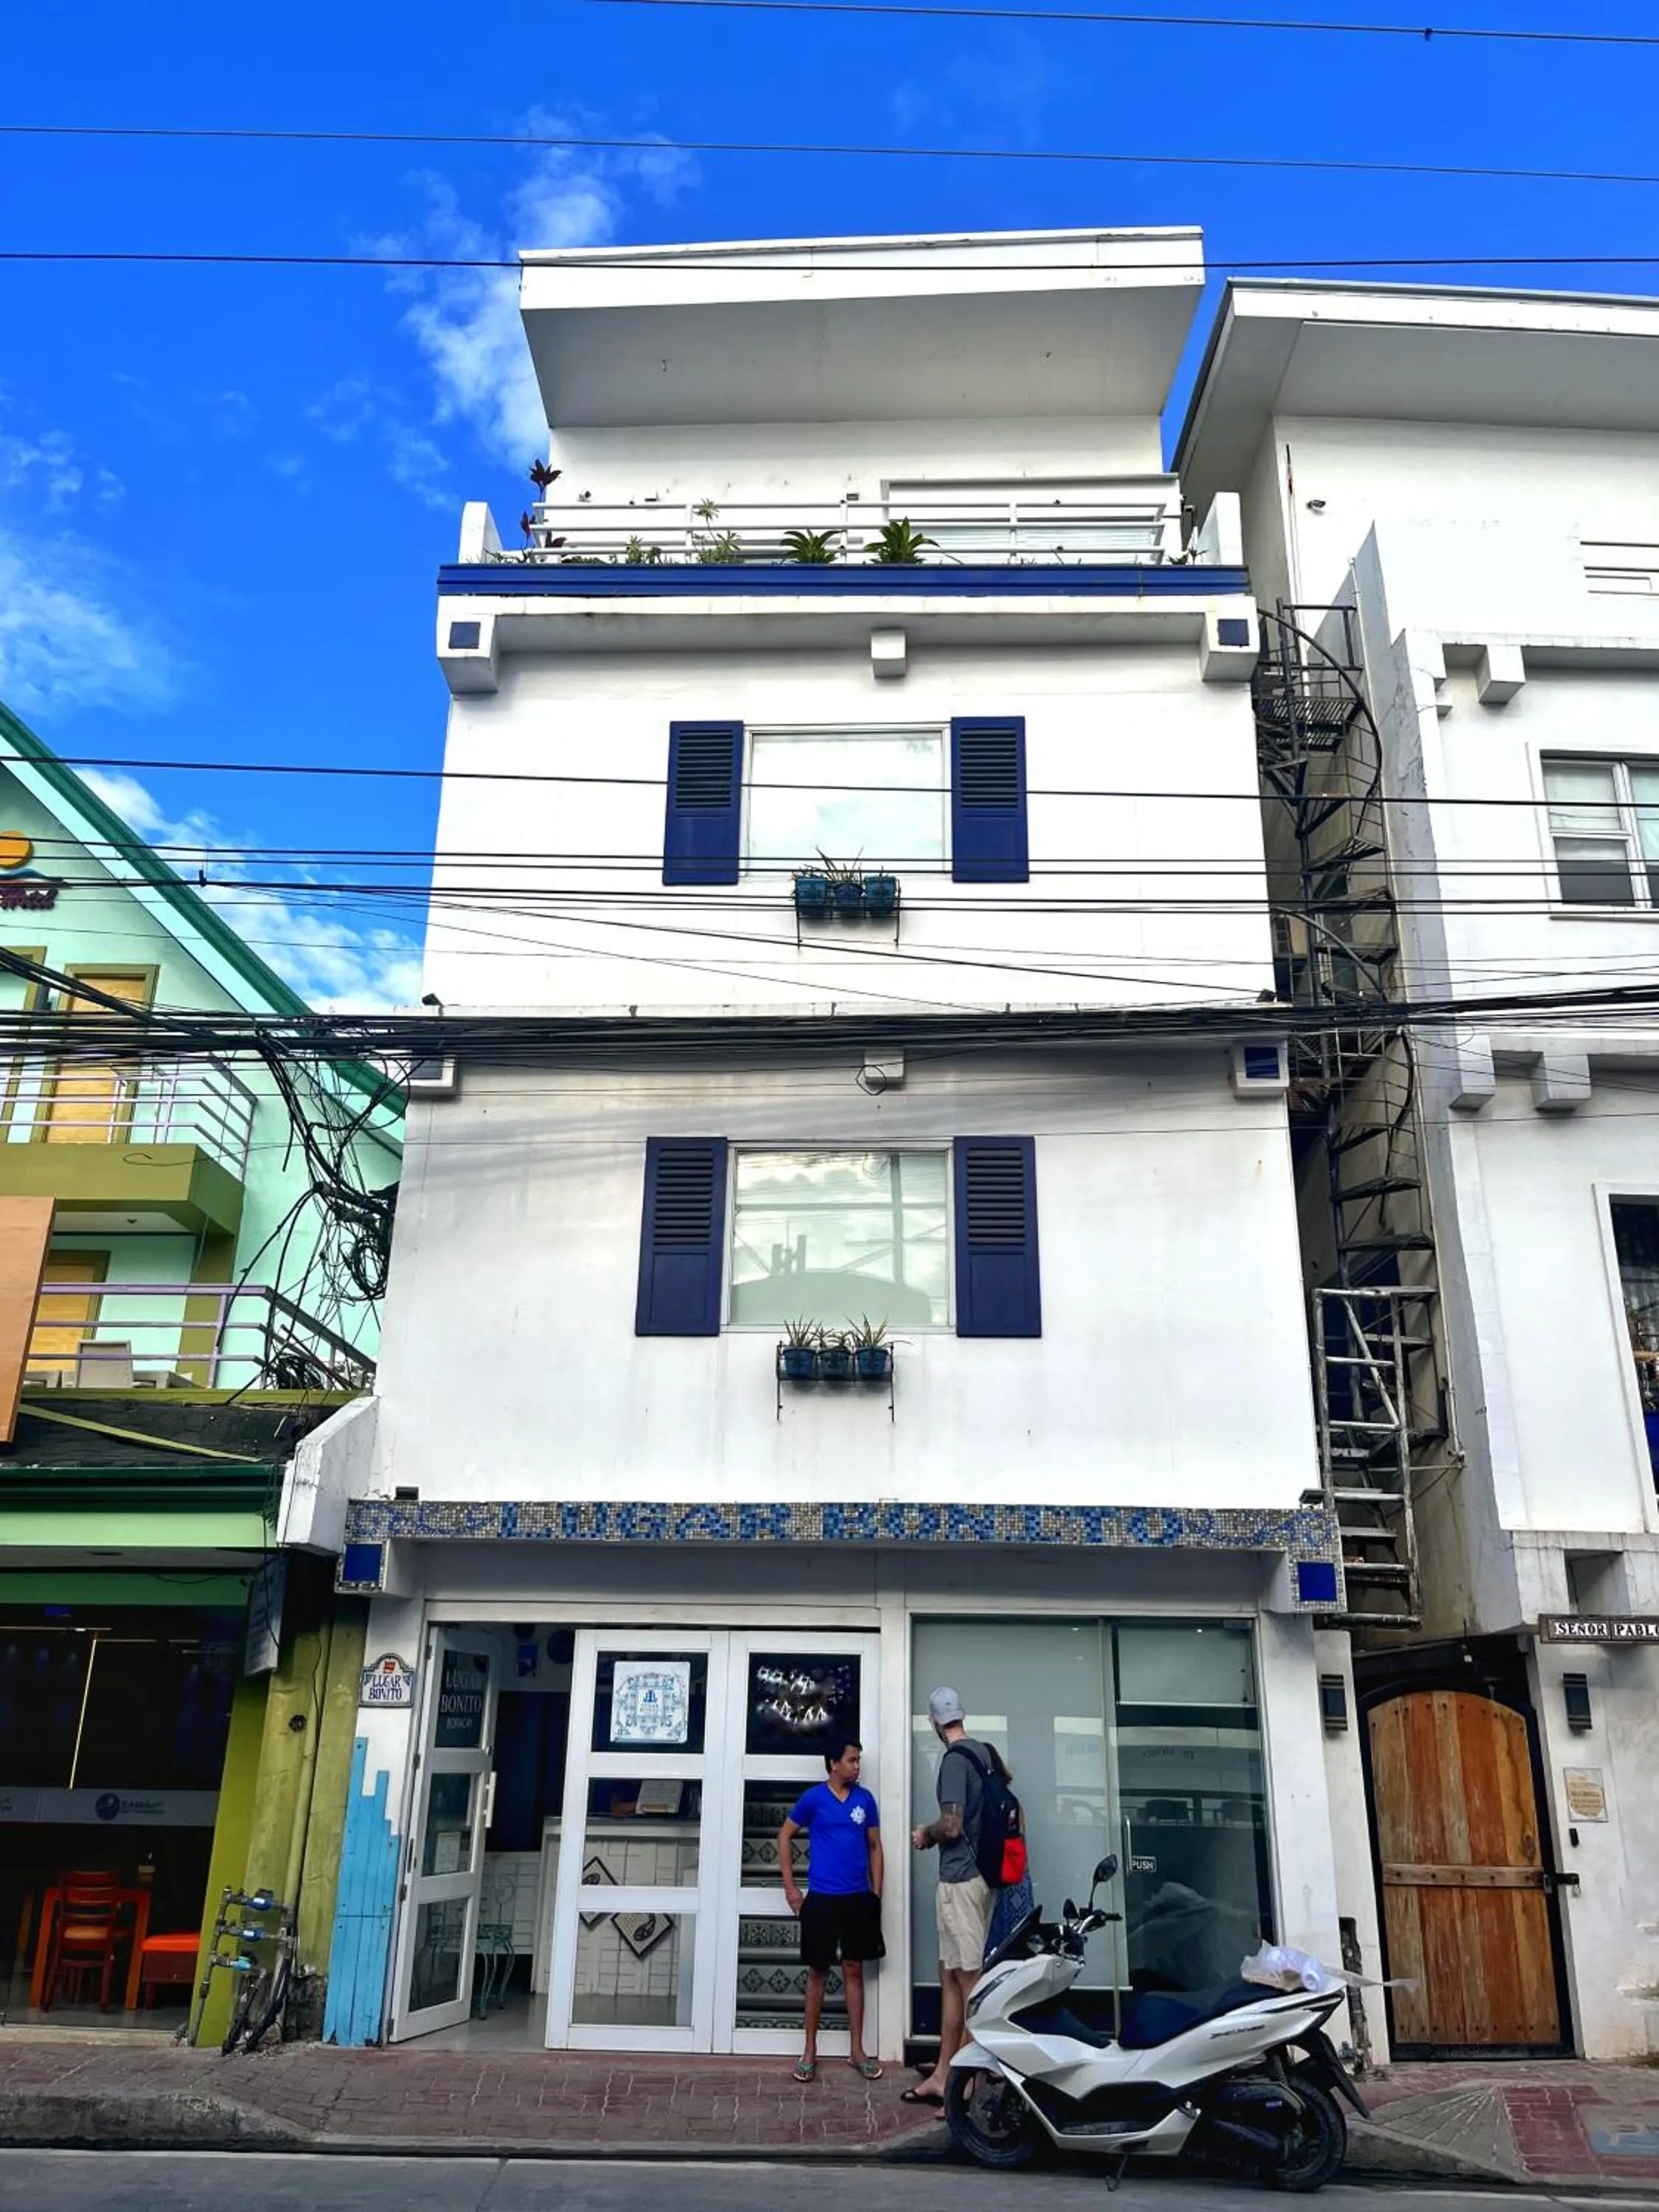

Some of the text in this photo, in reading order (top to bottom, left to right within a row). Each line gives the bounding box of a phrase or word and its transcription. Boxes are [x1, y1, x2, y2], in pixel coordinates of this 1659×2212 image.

[497, 1502, 1183, 1548] LUGAR BONITO
[372, 1674, 401, 1688] LUGAR
[369, 1688, 402, 1700] BONITO
[440, 1694, 481, 1713] BONITO
[1132, 1860, 1154, 1870] PUSH
